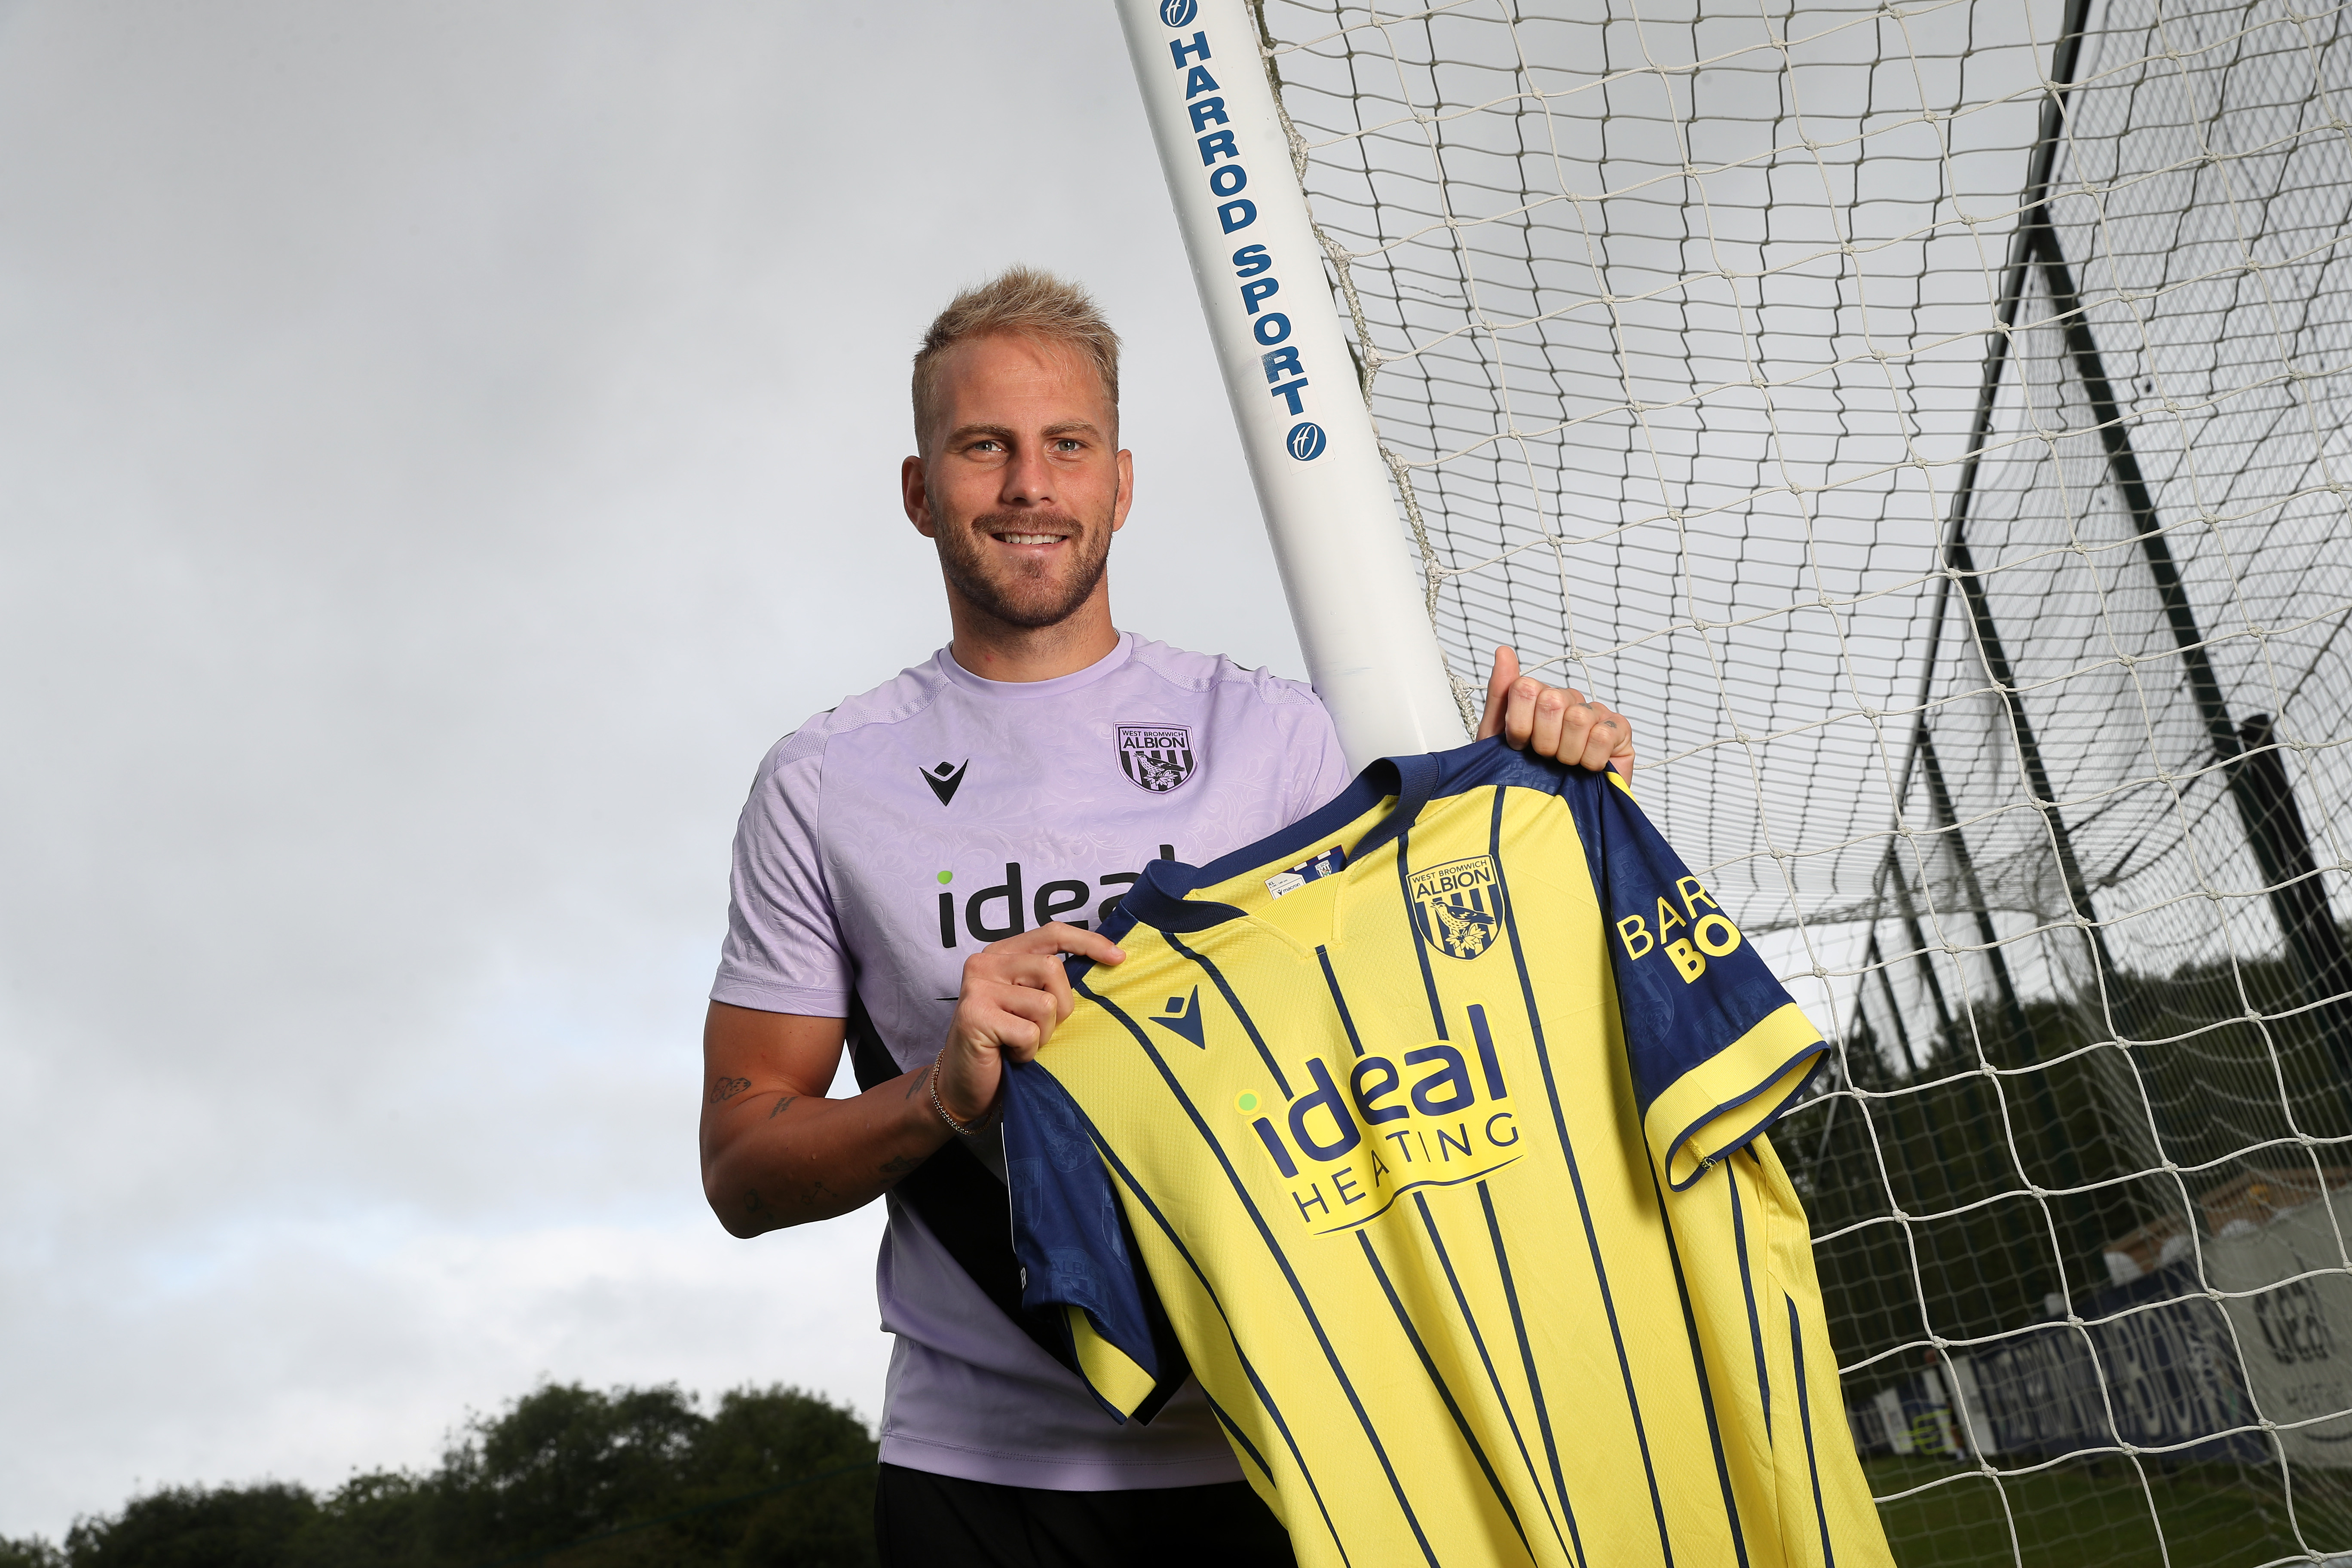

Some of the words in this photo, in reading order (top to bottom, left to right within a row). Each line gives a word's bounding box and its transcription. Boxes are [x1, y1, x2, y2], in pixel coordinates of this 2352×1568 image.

[1170, 31, 1257, 235] HARROD
[1232, 244, 1309, 416] SPORT
[1123, 737, 1185, 749] ALBION
[1283, 882, 1300, 893] macron
[1412, 872, 1436, 883] WEST
[1439, 860, 1487, 876] BROMWICH
[1416, 867, 1490, 899] ALBION
[1616, 876, 1718, 961] BAR
[1664, 914, 1742, 984] BO
[1238, 1004, 1507, 1179] ideal
[1292, 1113, 1519, 1223] HEATING
